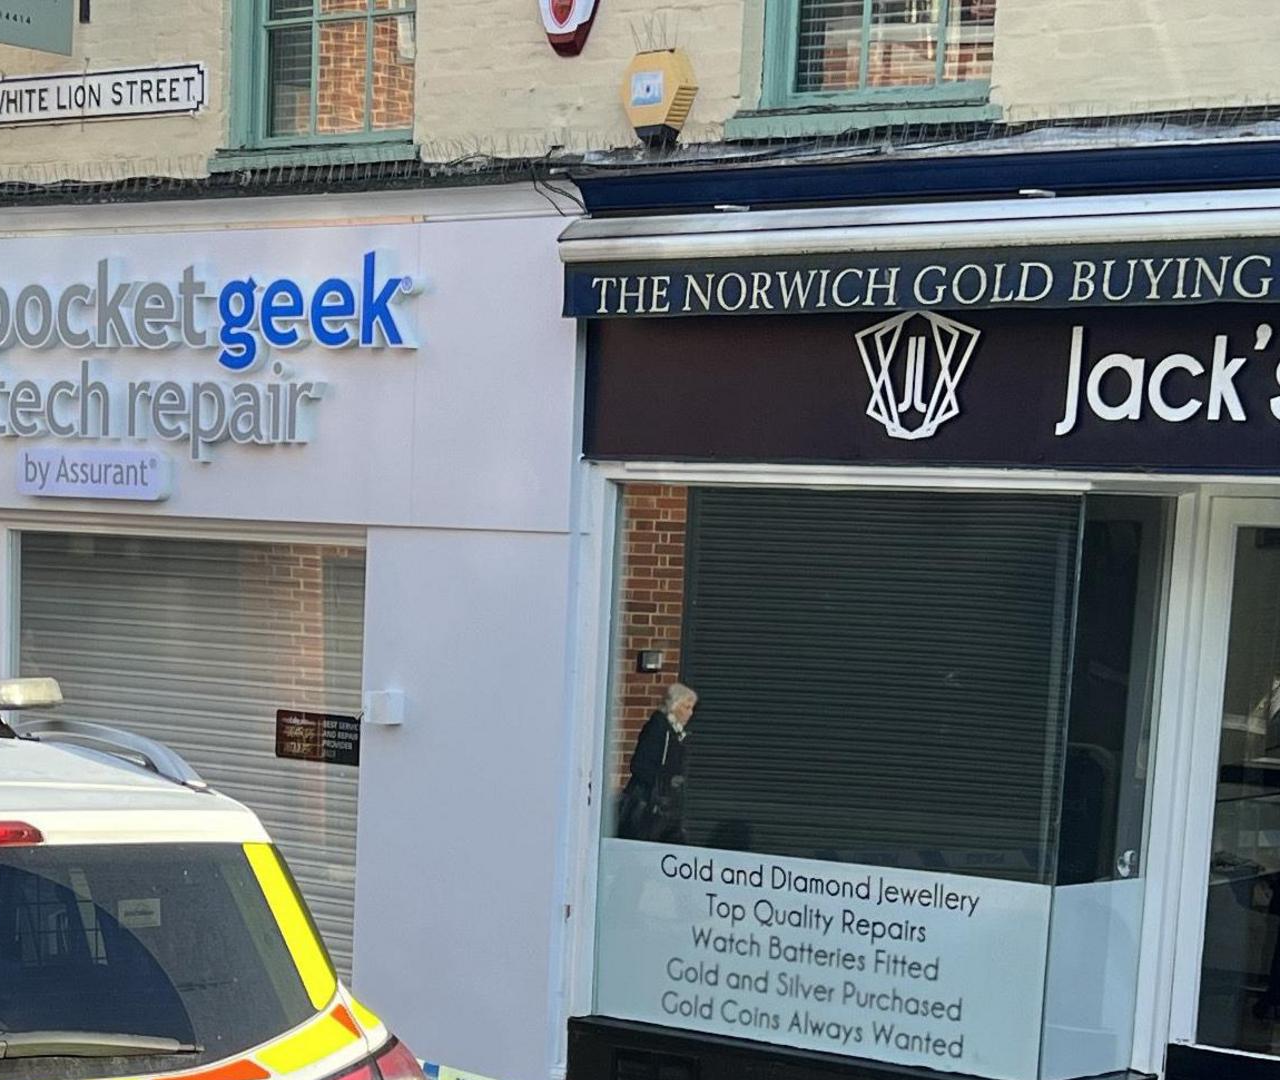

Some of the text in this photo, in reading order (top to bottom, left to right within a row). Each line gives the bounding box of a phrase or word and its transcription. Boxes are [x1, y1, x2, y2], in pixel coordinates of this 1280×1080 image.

[58, 84, 102, 109] LION
[218, 250, 403, 370] geek
[592, 276, 671, 313] THE
[683, 267, 900, 310] NORWICH
[913, 261, 1053, 304] GOLD
[1069, 254, 1273, 301] BUYING
[127, 362, 320, 462] repair
[24, 453, 51, 486] by
[661, 854, 980, 917] Gold and Diamond Jewellery
[705, 893, 926, 943] Top Quality Repairs
[692, 926, 939, 981] Watch Batteries Fitted
[667, 958, 962, 1022] Gold and Silver Purchased
[661, 990, 963, 1059] Gold Coins Always Wanted
